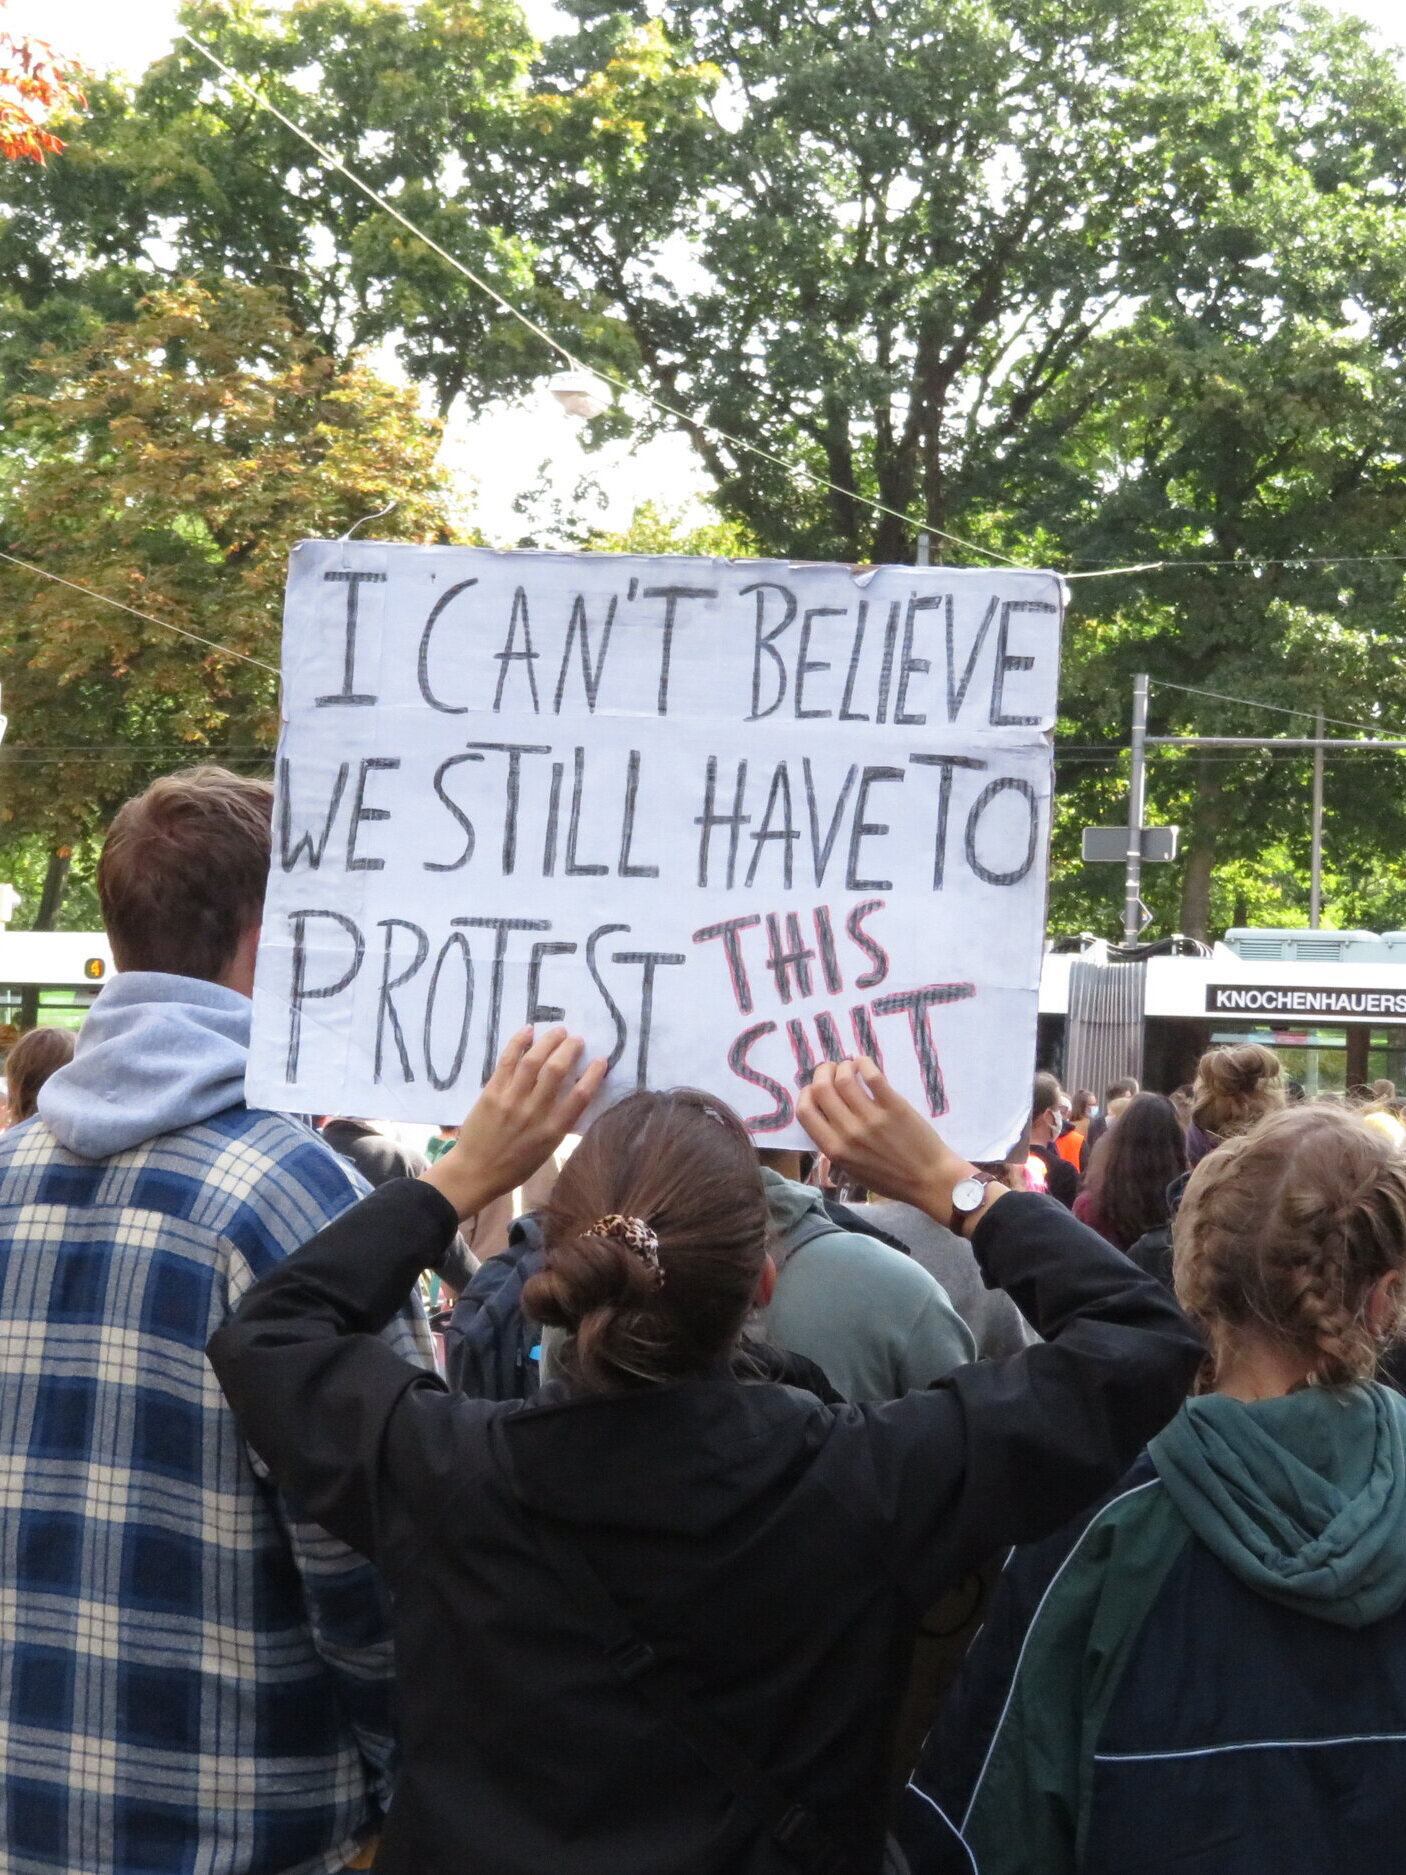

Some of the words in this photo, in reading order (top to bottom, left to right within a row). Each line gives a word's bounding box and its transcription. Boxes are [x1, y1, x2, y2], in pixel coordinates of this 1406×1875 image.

[315, 571, 388, 708] I
[417, 577, 718, 717] CAN'T
[739, 583, 1058, 727] BELIEVE
[280, 756, 401, 872] WE
[422, 742, 659, 878] STILL
[694, 755, 905, 890] HAVE
[909, 753, 1039, 891] TO
[90, 960, 102, 977] 4
[286, 909, 686, 1091] PROTEST
[692, 899, 890, 1016] THIS
[1216, 990, 1406, 1013] KNOCHENHAUERS
